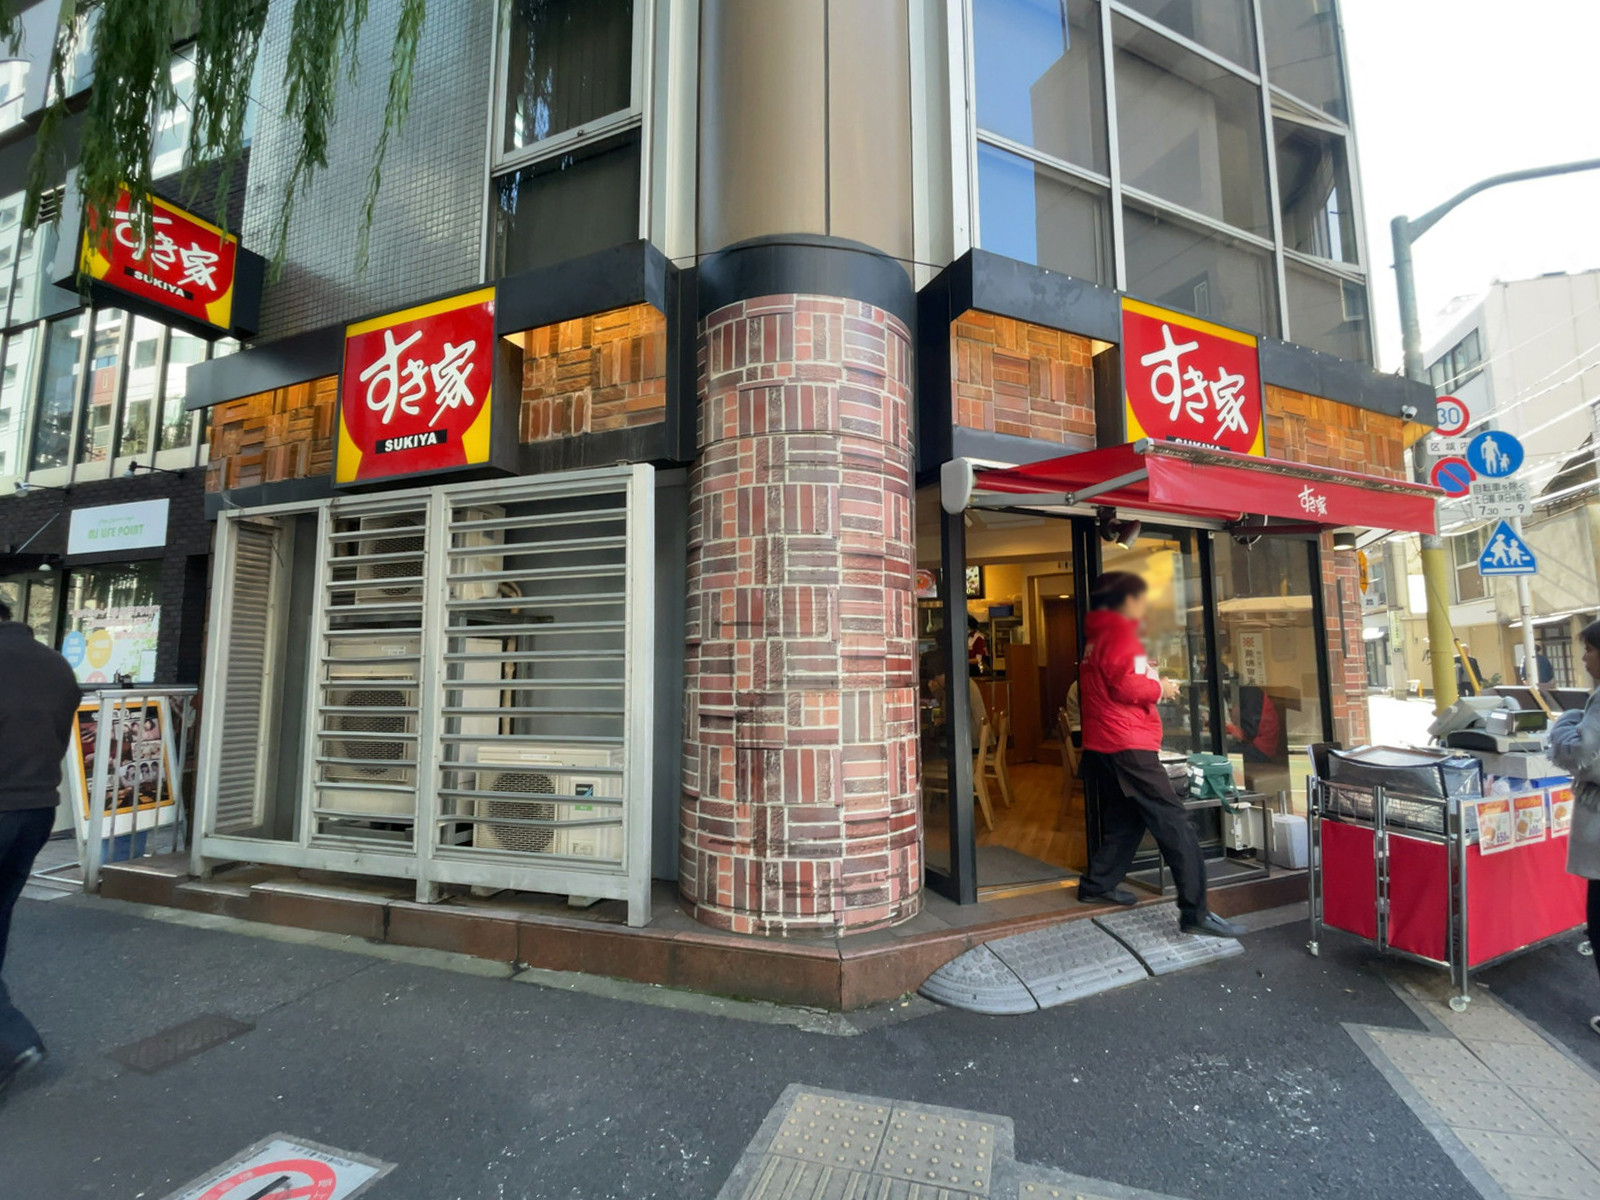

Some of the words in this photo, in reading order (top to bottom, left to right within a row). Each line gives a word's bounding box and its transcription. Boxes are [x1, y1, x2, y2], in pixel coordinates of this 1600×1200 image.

[109, 199, 219, 292] すき家
[134, 270, 186, 298] SUKIYA
[359, 329, 476, 427] すき家
[1140, 323, 1249, 440] すき家
[1437, 407, 1460, 425] 30
[384, 432, 438, 452] SUKIYA
[1298, 484, 1328, 517] すき家
[1517, 503, 1525, 514] 9
